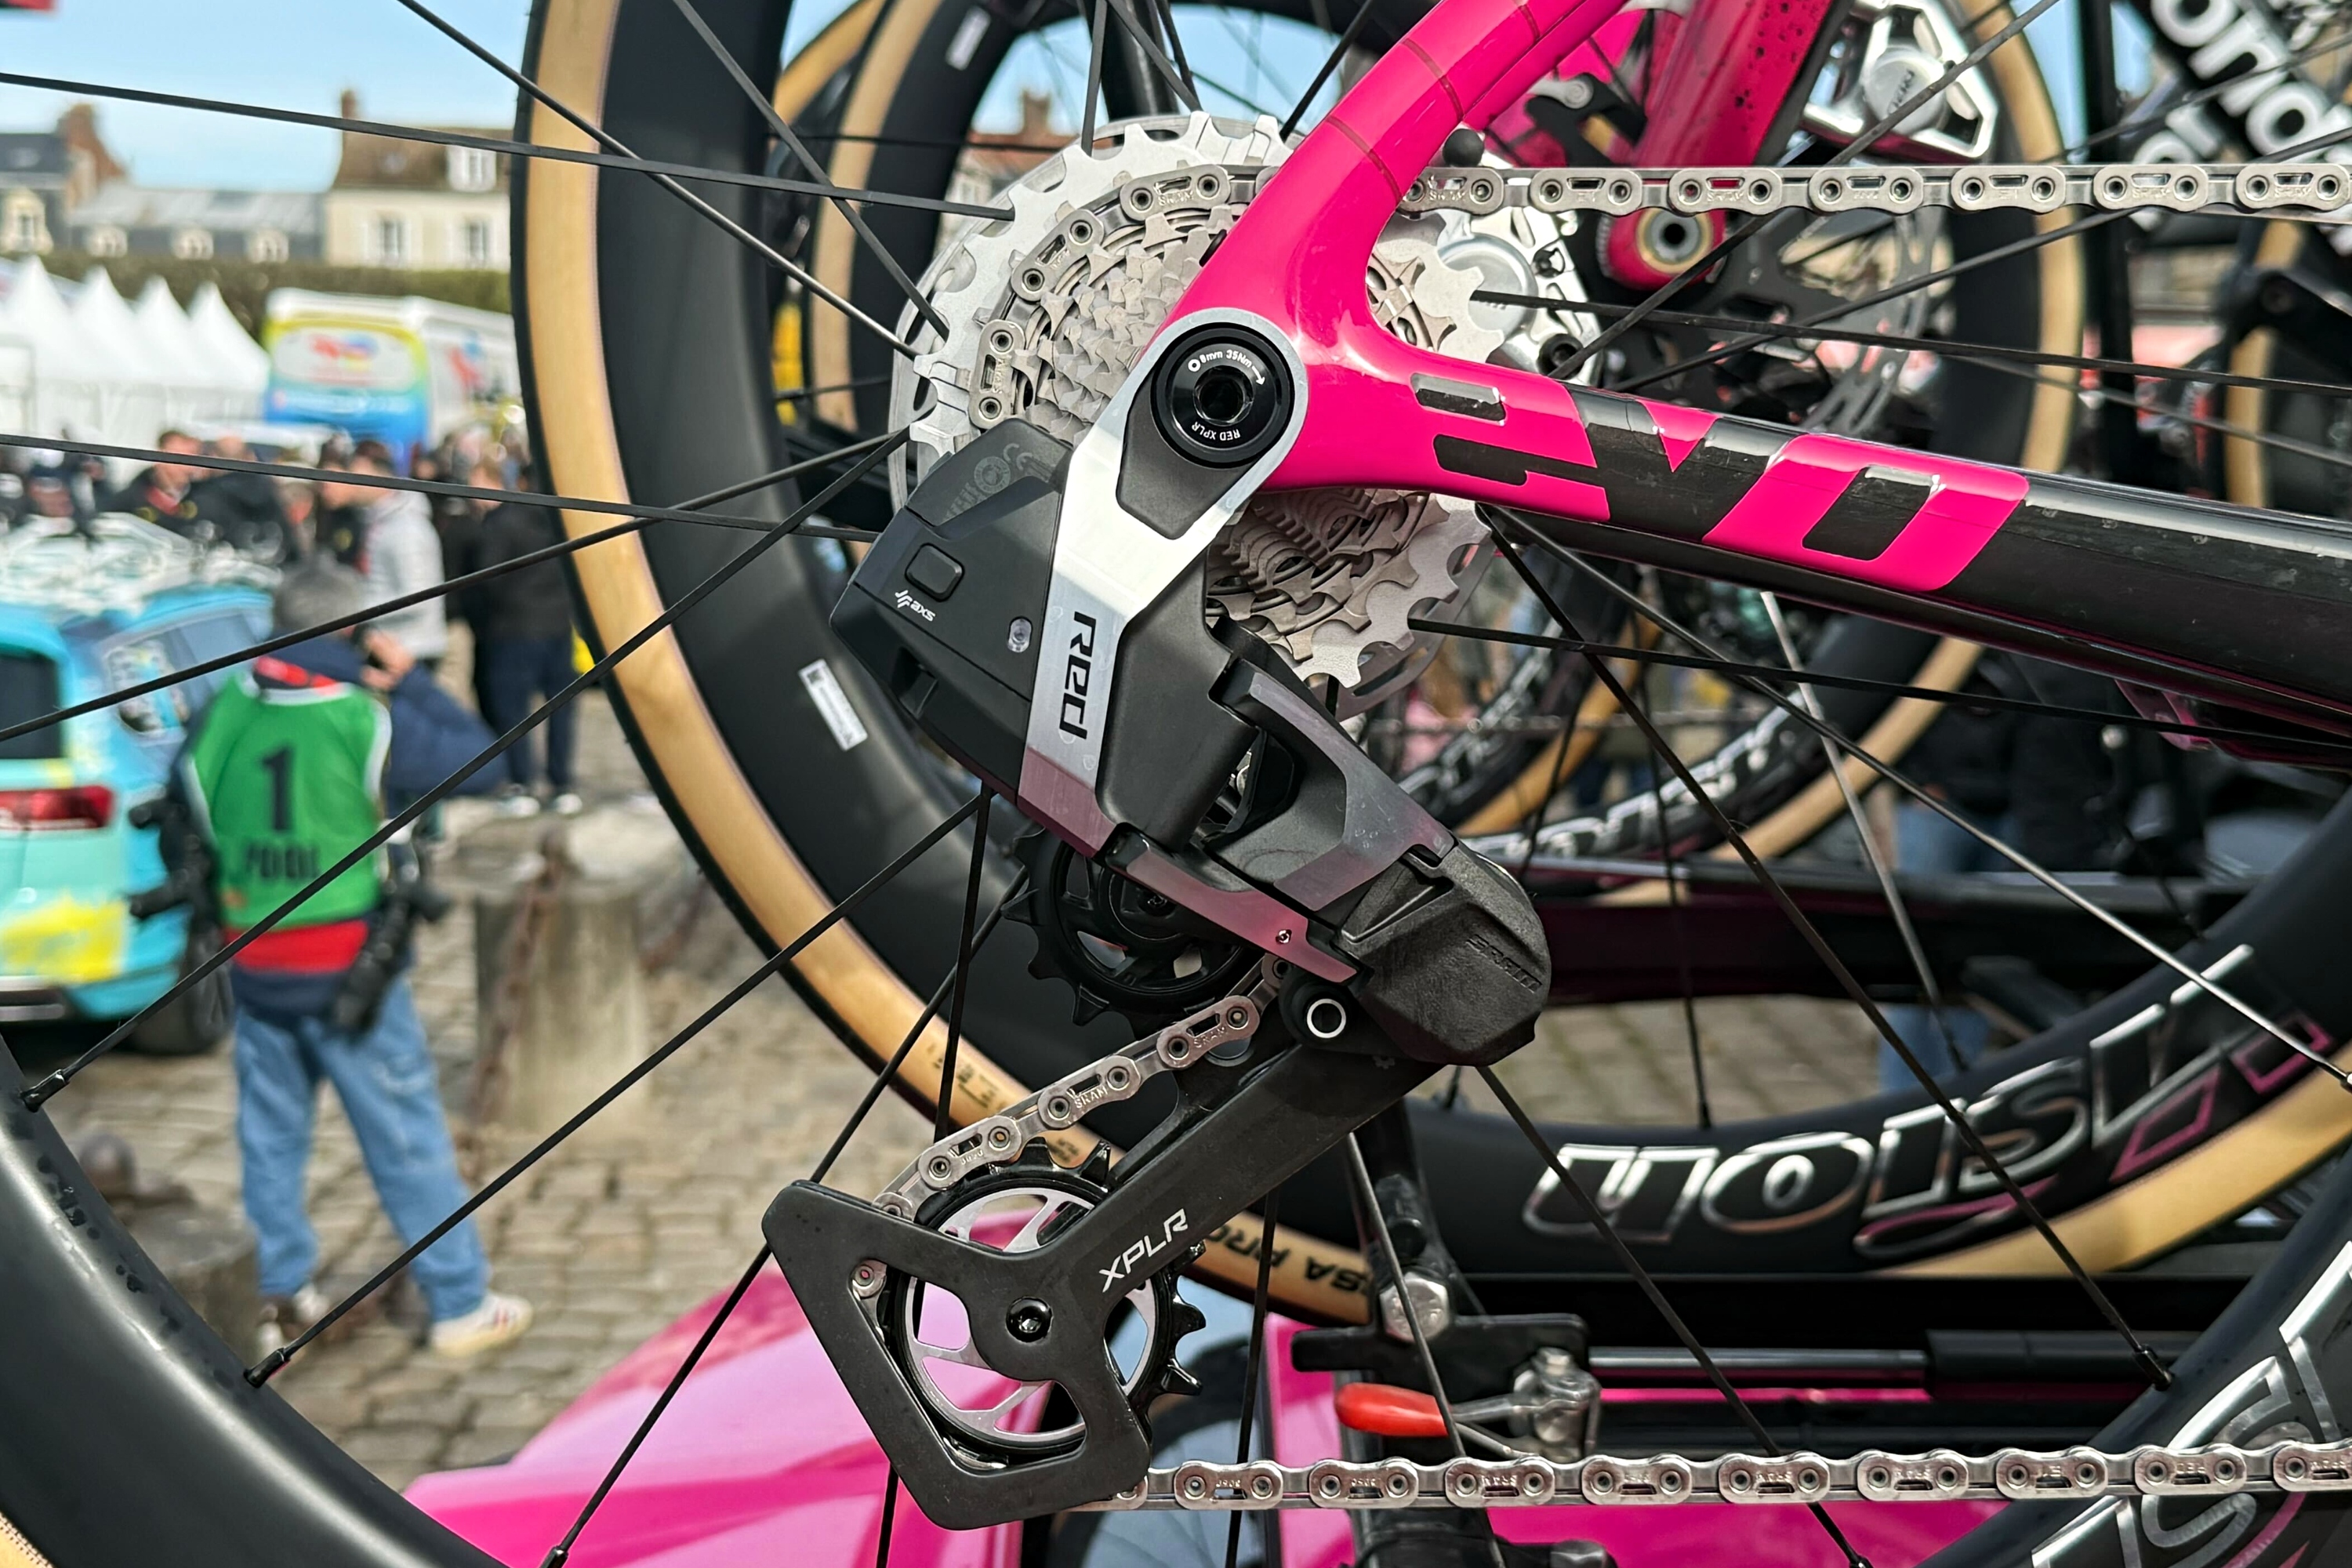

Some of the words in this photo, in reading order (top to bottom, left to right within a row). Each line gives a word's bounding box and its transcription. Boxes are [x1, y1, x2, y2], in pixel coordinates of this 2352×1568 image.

[1225, 349, 1253, 368] 35Nm
[1191, 421, 1218, 440] XPLR
[1219, 429, 1241, 441] RED
[260, 743, 296, 832] 1
[1192, 1025, 1228, 1048] SRAM
[1073, 1086, 1108, 1109] SRAM
[1098, 1207, 1189, 1293] XPLR
